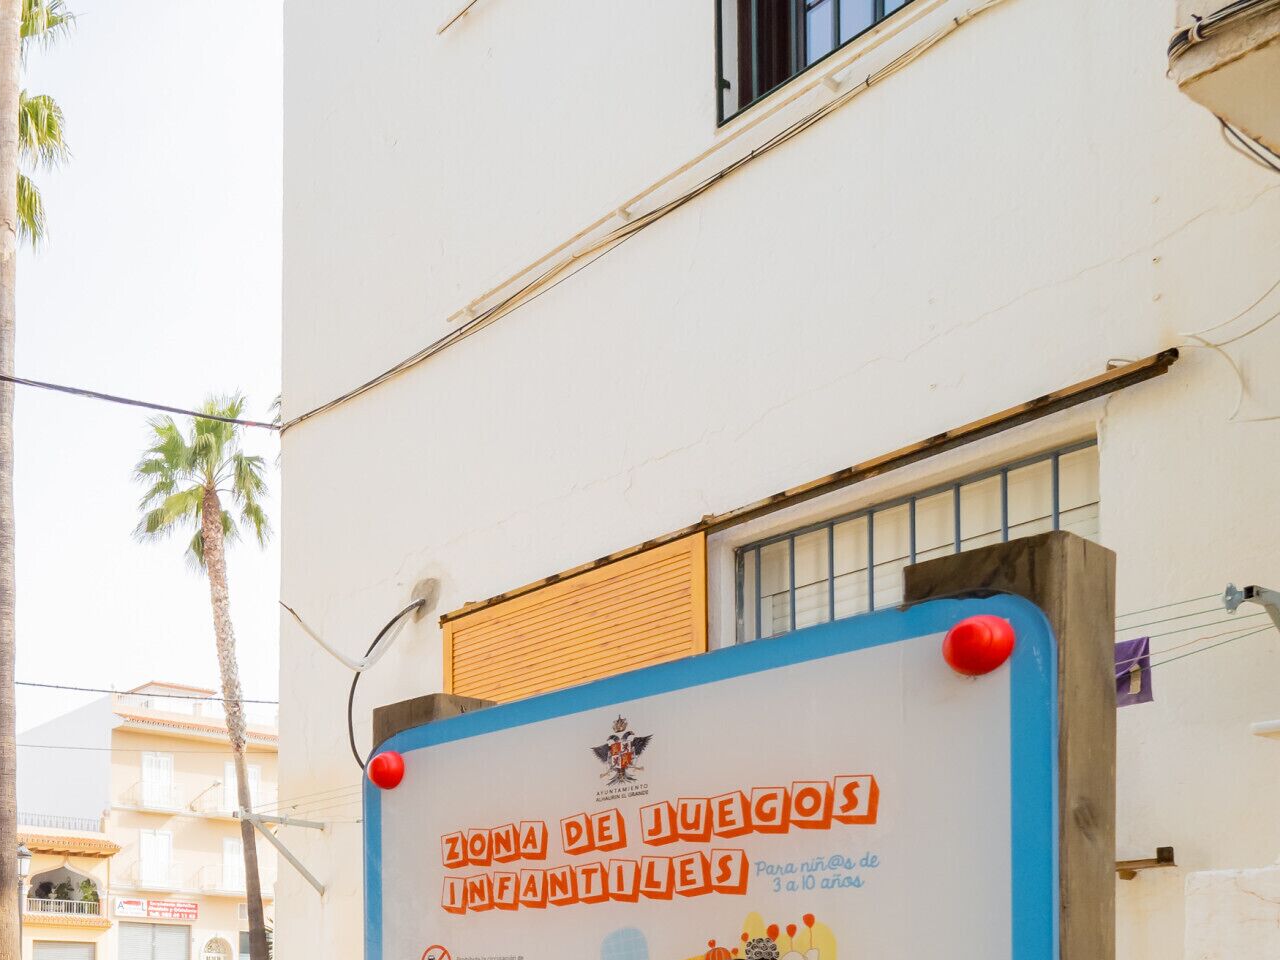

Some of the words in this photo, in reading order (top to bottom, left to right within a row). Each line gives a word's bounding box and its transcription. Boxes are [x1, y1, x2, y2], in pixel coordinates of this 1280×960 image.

[596, 784, 648, 795] AYUNTAMIENTO
[441, 822, 548, 868] ZONA
[561, 808, 626, 854] DE
[640, 775, 879, 846] JUEGOS
[755, 860, 799, 877] Para
[861, 852, 881, 870] de
[442, 849, 748, 914] INFANTILES
[773, 878, 782, 892] 3
[786, 880, 798, 890] a
[802, 874, 816, 890] 10
[820, 872, 865, 890] años
